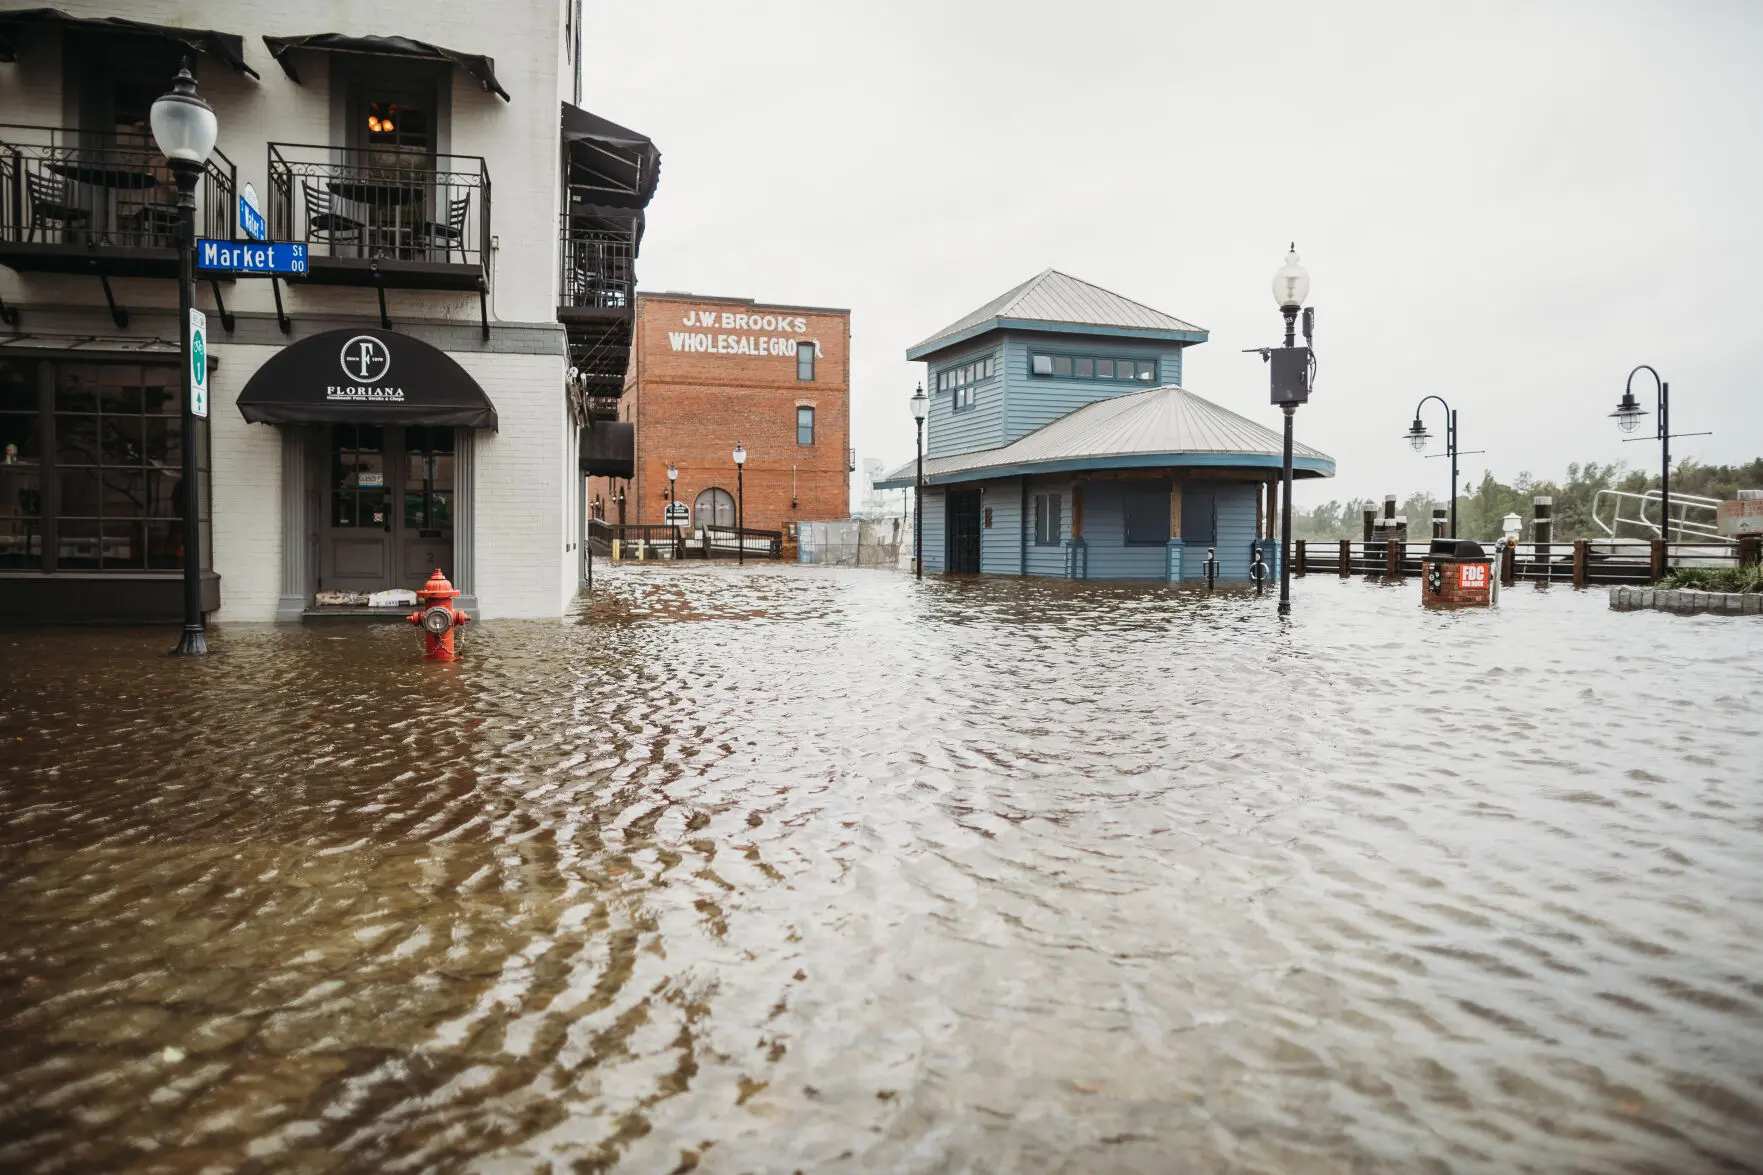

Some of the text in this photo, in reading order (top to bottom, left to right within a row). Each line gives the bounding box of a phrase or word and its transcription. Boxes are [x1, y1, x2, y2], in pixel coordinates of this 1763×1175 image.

[205, 243, 303, 268] Market St
[291, 260, 304, 272] 00
[682, 310, 807, 333] J.W. BROOKS
[668, 331, 768, 356] WHOLESALE
[360, 342, 373, 376] F
[197, 361, 201, 381] 1
[327, 386, 405, 396] FLORIANA
[427, 552, 434, 563] 2
[1462, 565, 1485, 581] FDC
